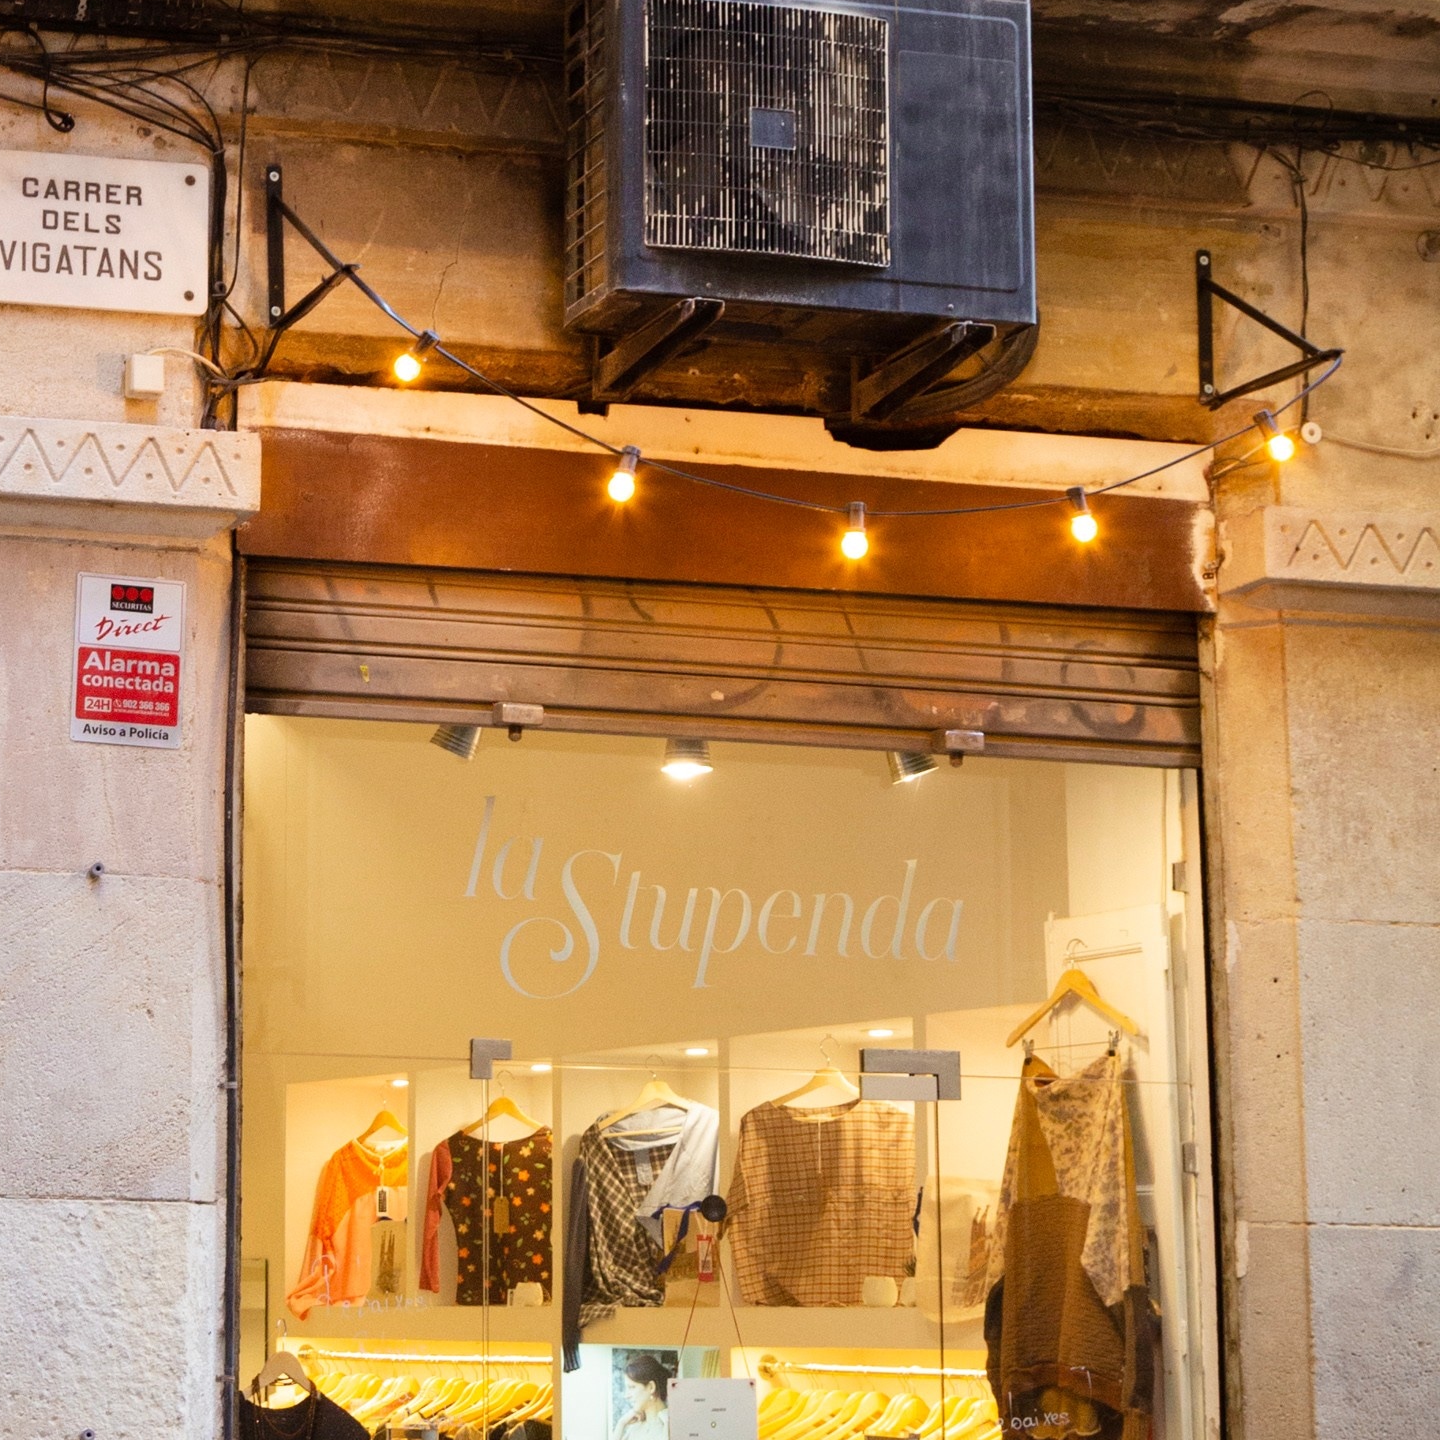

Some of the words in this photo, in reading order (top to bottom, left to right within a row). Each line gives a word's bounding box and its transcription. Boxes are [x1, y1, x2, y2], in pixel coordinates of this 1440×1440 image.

[22, 177, 143, 206] CARRER
[42, 210, 121, 234] DELS
[0, 239, 162, 281] VIGATANS
[111, 601, 152, 611] SECURITAS
[95, 614, 172, 641] Direct
[83, 651, 175, 677] Alarma
[82, 673, 174, 693] conectada
[86, 698, 110, 710] 24H
[83, 723, 116, 736] Aviso
[119, 728, 126, 737] a
[129, 726, 169, 740] Policía
[462, 796, 543, 900] la
[500, 850, 963, 999] Stupenda
[994, 1391, 1071, 1433] ebaixes
